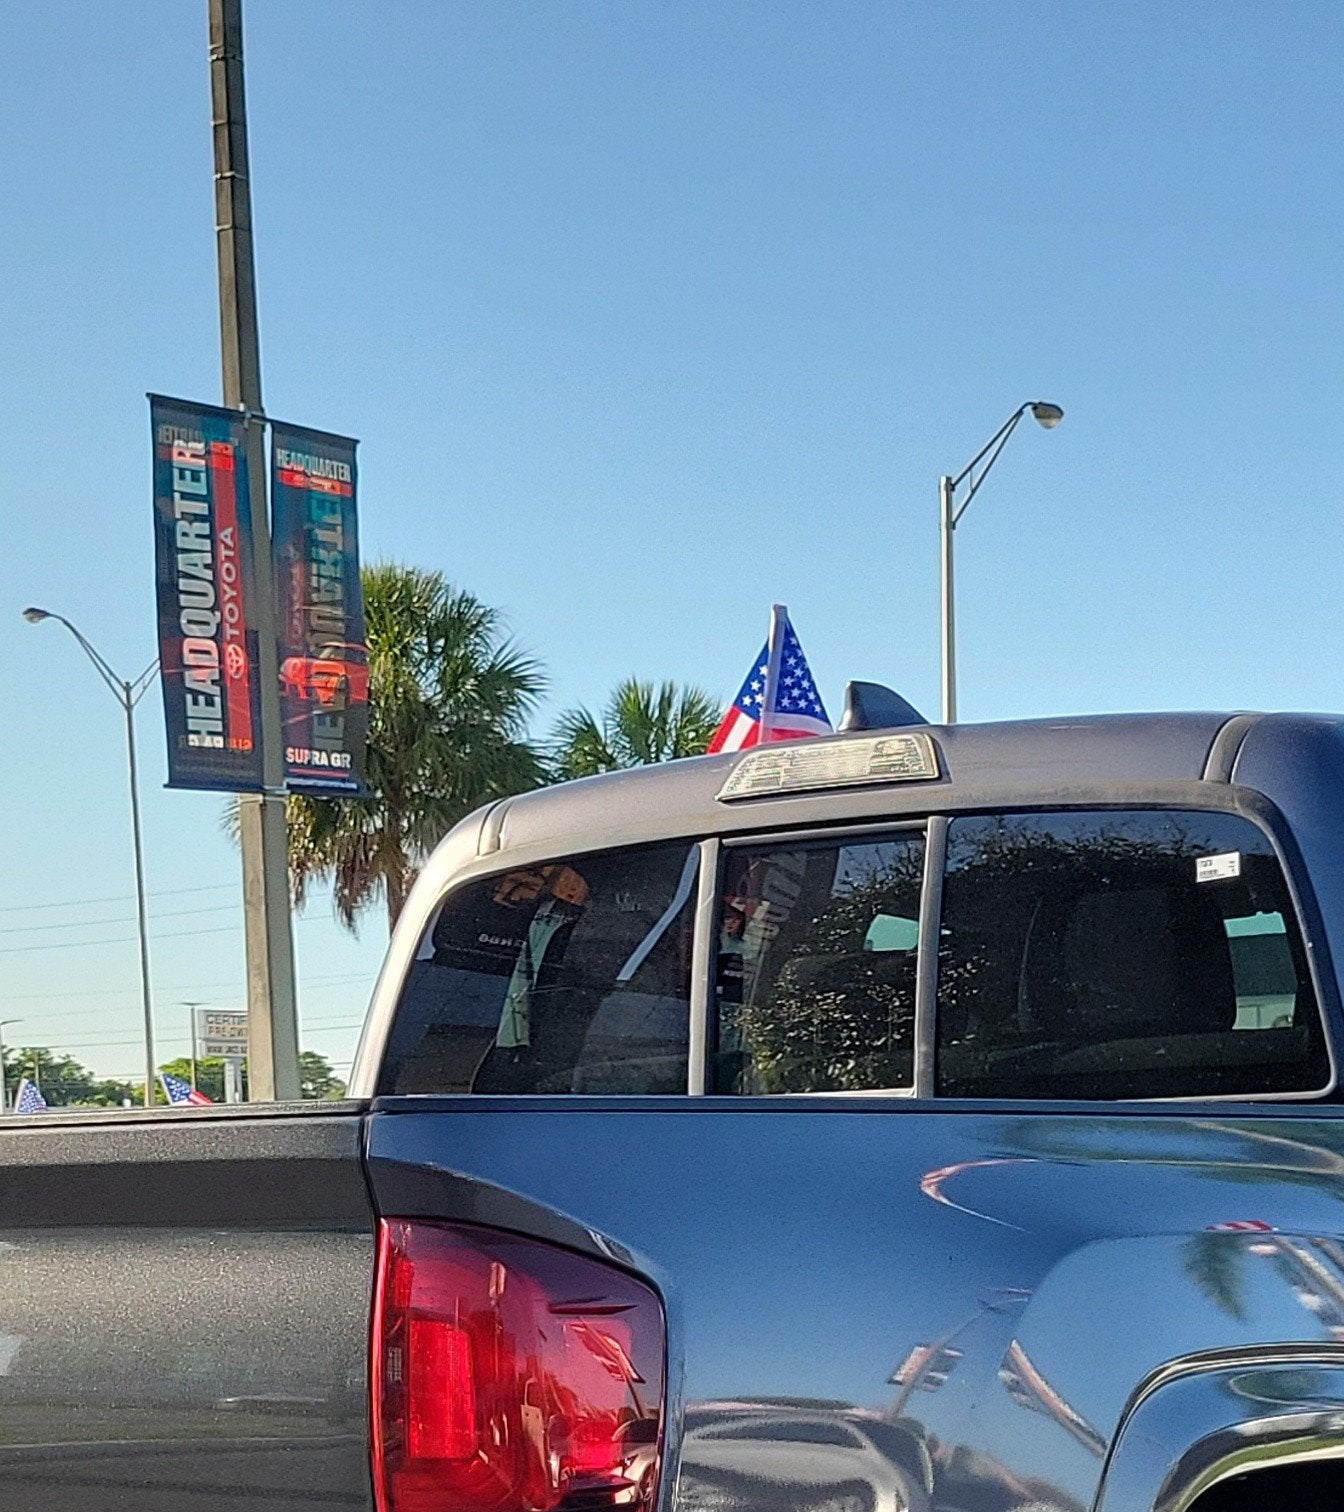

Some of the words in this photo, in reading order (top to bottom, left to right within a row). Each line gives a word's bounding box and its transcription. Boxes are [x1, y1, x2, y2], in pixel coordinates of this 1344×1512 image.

[276, 448, 352, 483] HEADQUARTER
[172, 439, 224, 749] HEADQUARTER
[218, 526, 244, 640] TOYOTA
[285, 747, 329, 767] SUPRA
[330, 751, 352, 769] GR
